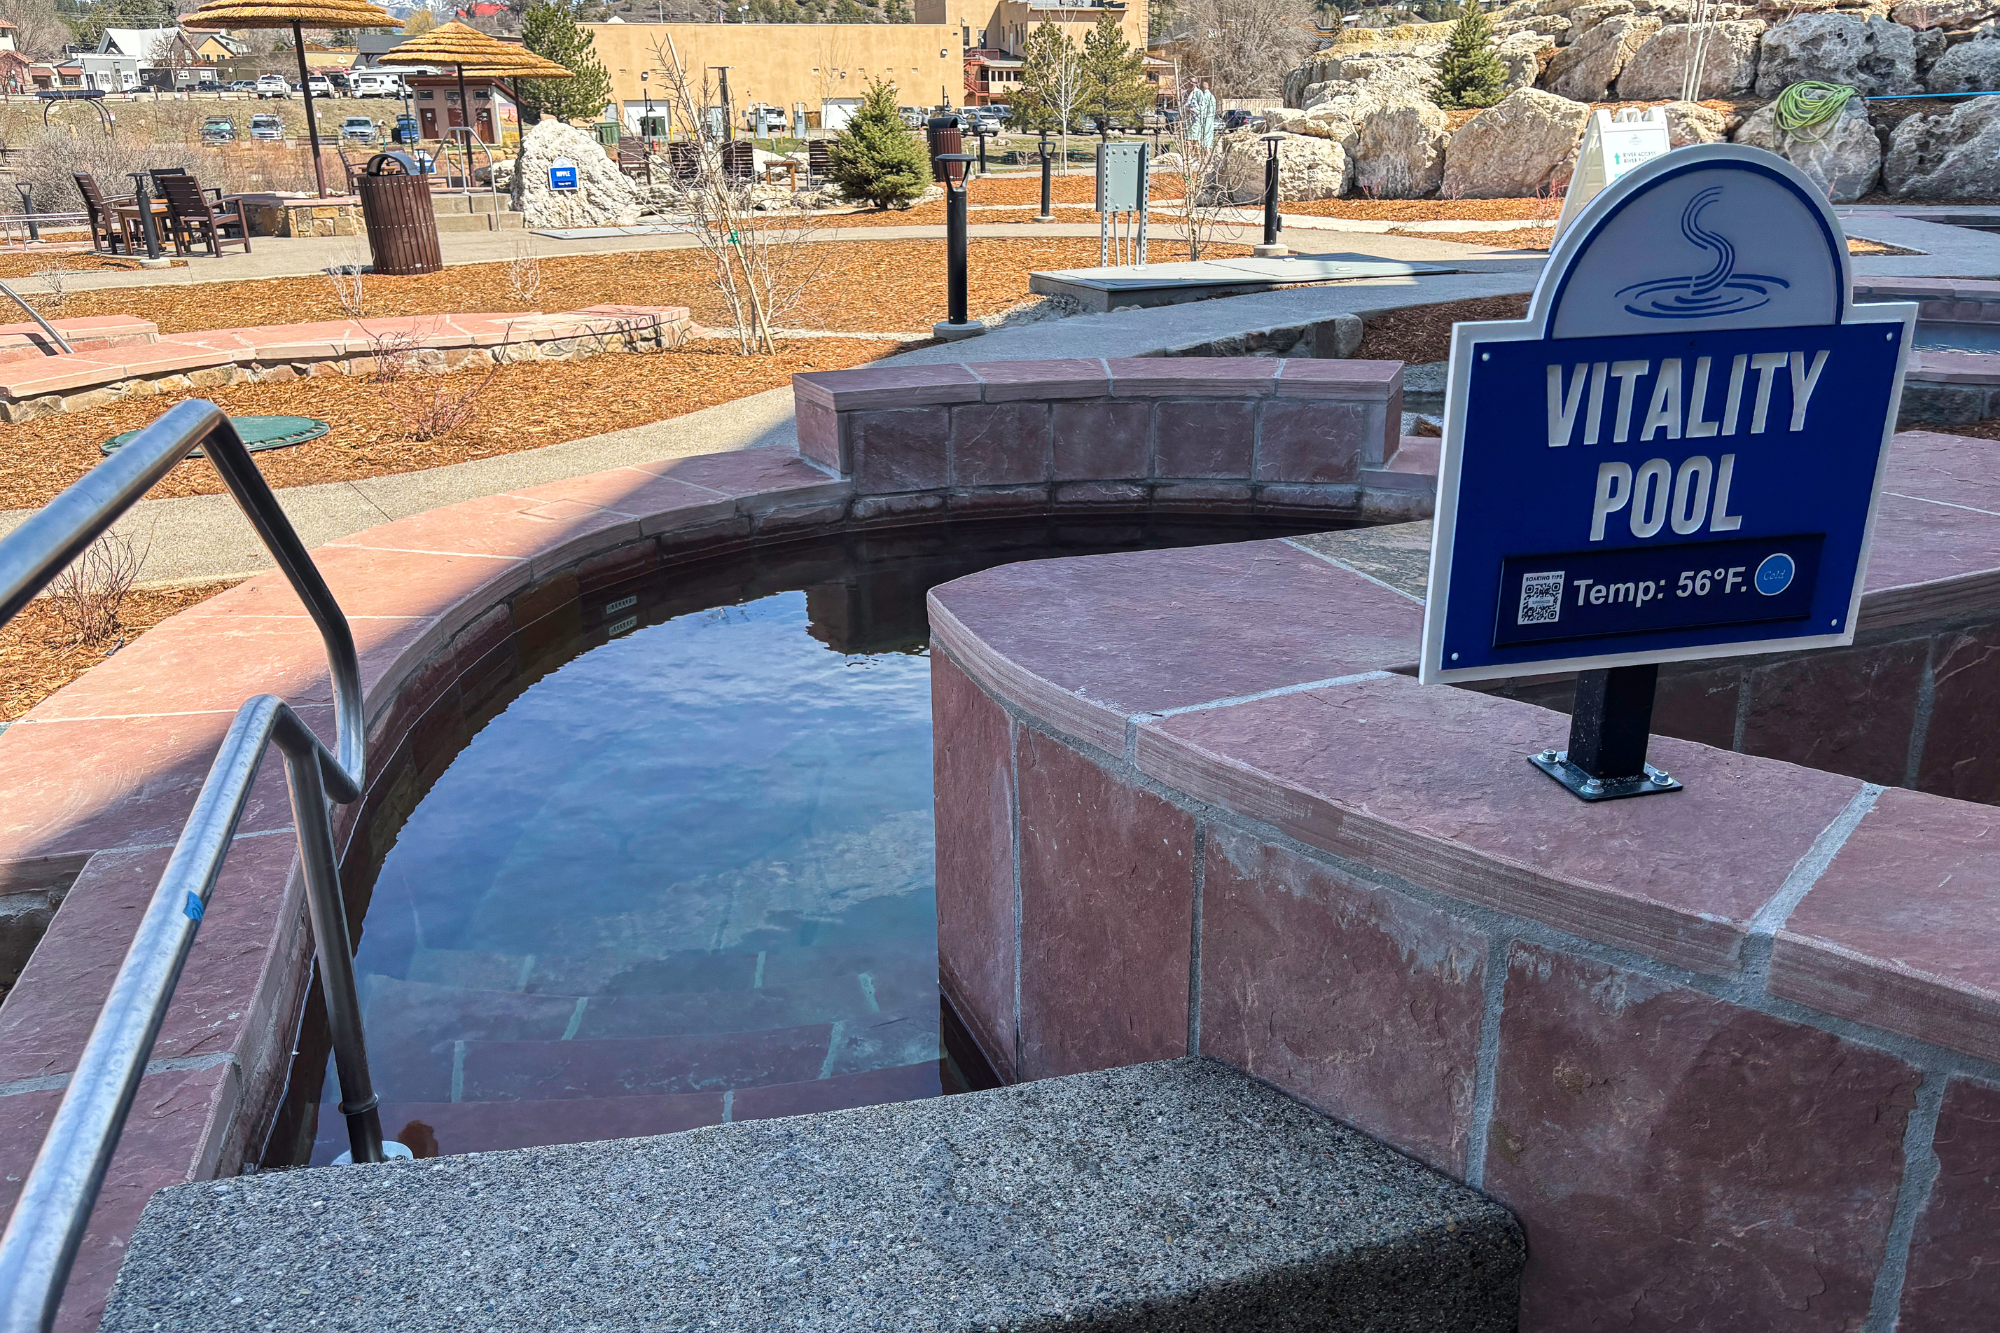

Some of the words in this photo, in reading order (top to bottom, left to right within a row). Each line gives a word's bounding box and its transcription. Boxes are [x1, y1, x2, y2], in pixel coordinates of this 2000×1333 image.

[1546, 350, 1831, 448] VITALITY
[1589, 454, 1743, 541] POOL
[1573, 579, 1666, 608] Temp:
[1763, 569, 1786, 581] Cold
